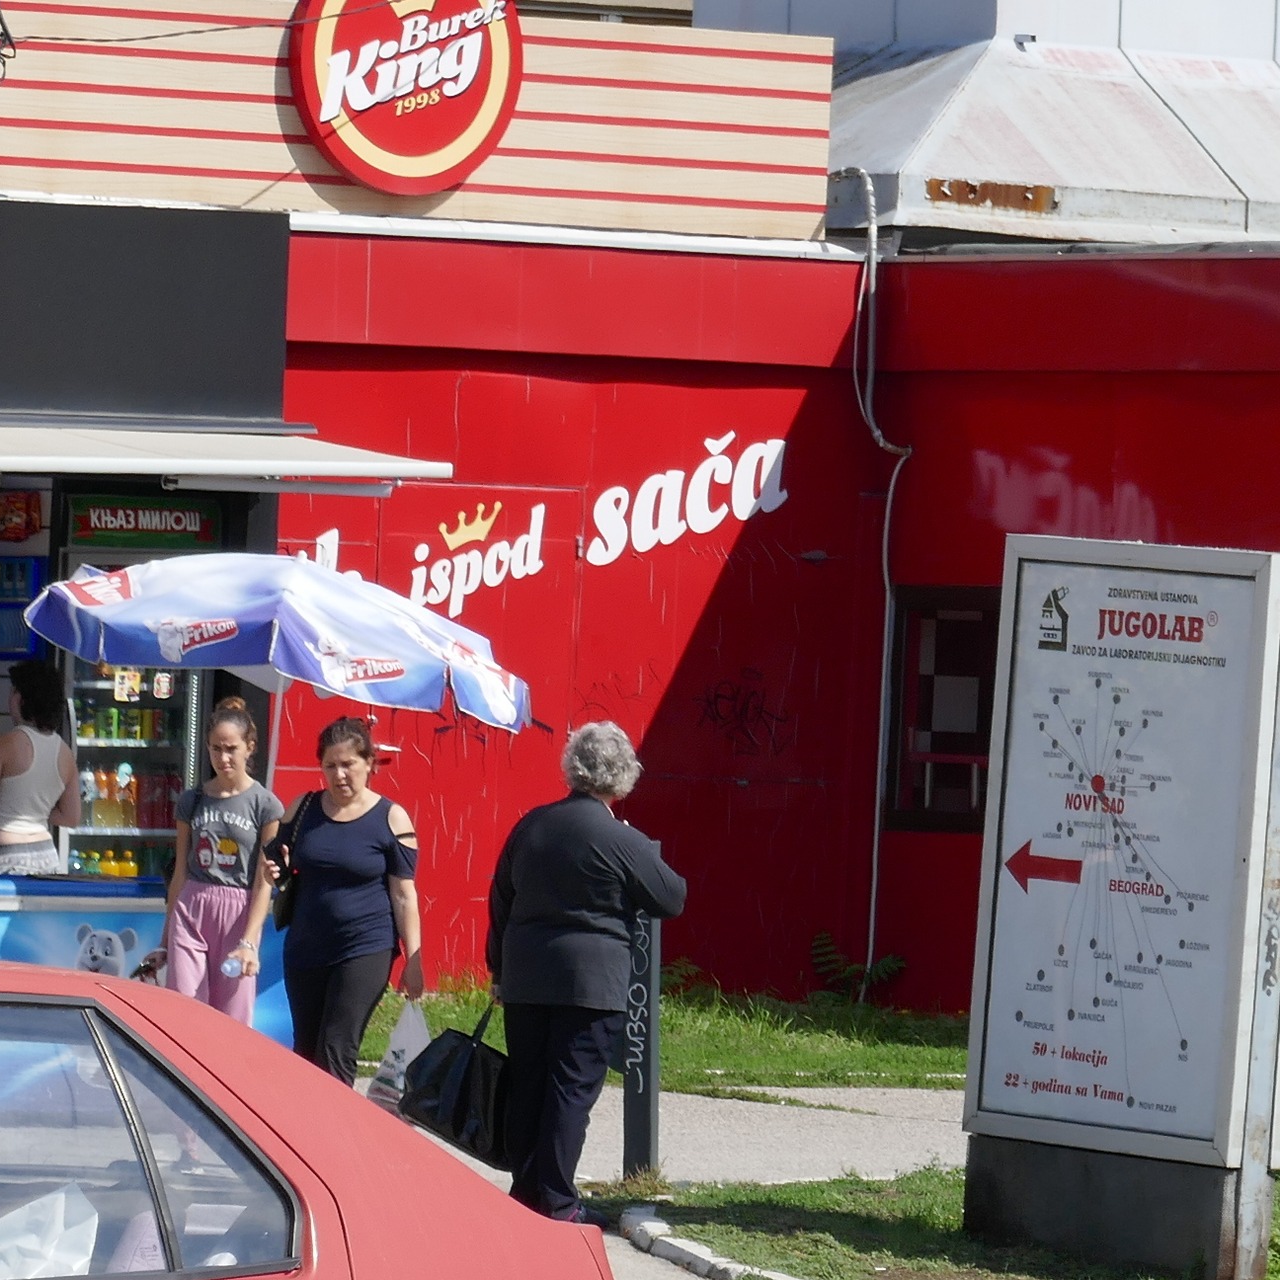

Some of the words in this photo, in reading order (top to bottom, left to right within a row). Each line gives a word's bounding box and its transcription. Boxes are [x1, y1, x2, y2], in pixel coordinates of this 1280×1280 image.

[400, 0, 507, 53] Burek
[320, 31, 483, 123] King
[395, 88, 441, 117] 1998
[587, 430, 788, 567] sača
[89, 507, 135, 529] КЊАЗ
[138, 509, 201, 532] МИЛОШ
[410, 502, 546, 619] ispod
[1108, 587, 1159, 602] ZDRAVSTVENA
[1160, 591, 1199, 605] USTANOVA
[182, 619, 237, 646] Frikom
[1097, 608, 1205, 643] JUGOLAB
[345, 658, 404, 681] Frikom
[1071, 643, 1097, 657] ZAVOD
[1098, 646, 1108, 658] ZA
[1109, 647, 1172, 663] LABORATORIJSKU
[1173, 653, 1227, 669] DIJAGNOSTIKU
[1065, 792, 1097, 813] NOVI
[1101, 797, 1125, 815] SAD
[1109, 879, 1165, 898] BEOGRAD
[1032, 1041, 1047, 1057] 50
[1060, 1045, 1109, 1068] lokacija
[1004, 1073, 1020, 1089] 22
[1031, 1078, 1072, 1097] godina
[1075, 1085, 1088, 1097] sa
[1092, 1083, 1124, 1104] Vama
